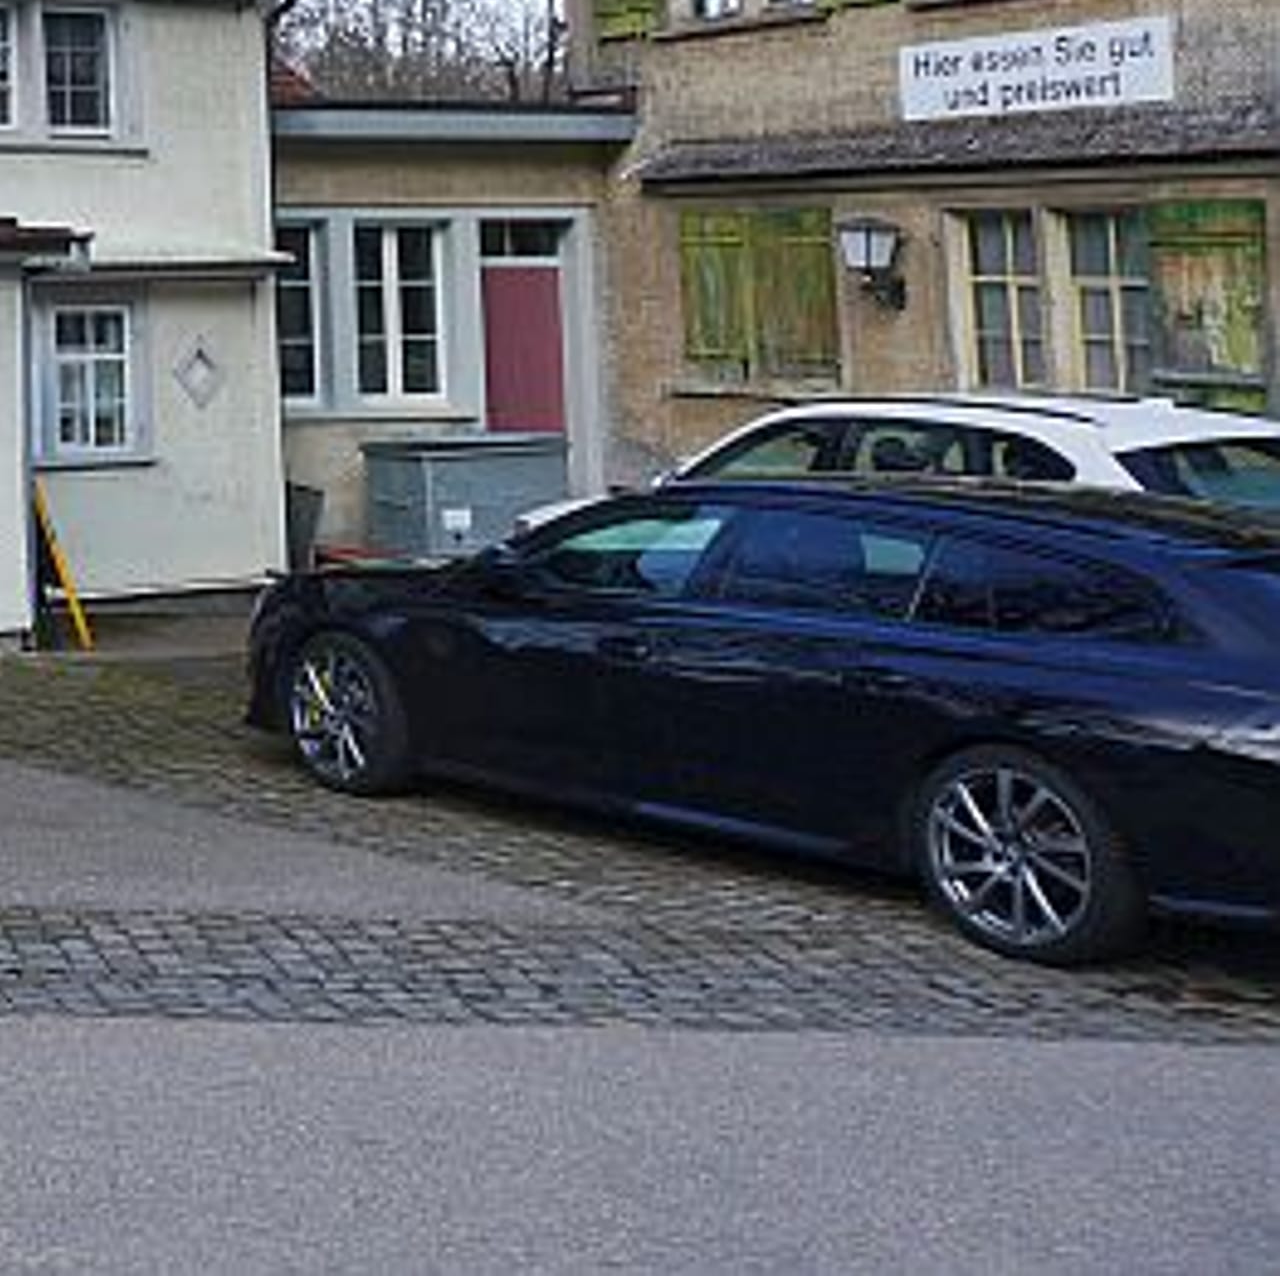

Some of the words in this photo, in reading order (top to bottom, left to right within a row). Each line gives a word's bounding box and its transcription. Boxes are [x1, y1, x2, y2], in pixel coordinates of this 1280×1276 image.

[913, 52, 962, 78] Hier
[970, 45, 1042, 73] essen
[1054, 35, 1096, 66] Sie
[1108, 31, 1154, 67] gut
[942, 80, 989, 111] und
[998, 71, 1121, 111] preiswert
